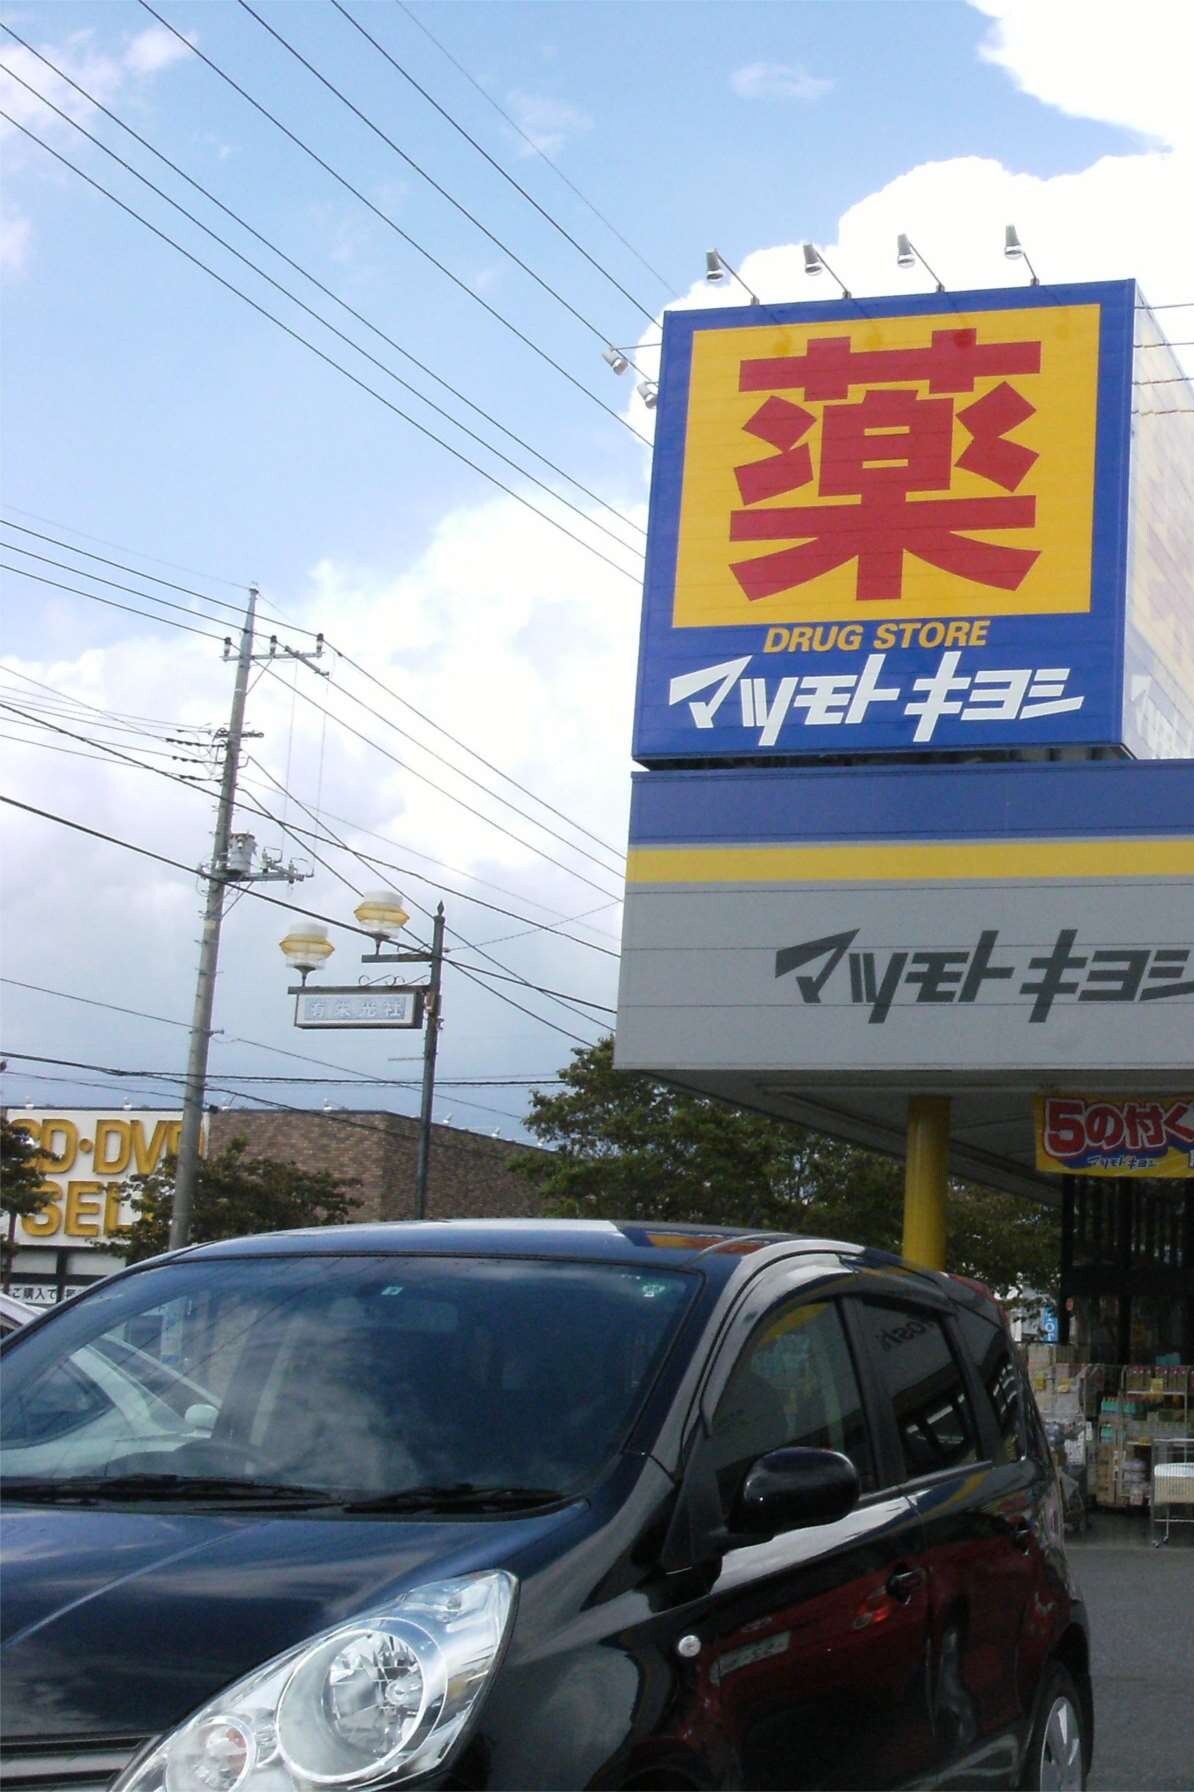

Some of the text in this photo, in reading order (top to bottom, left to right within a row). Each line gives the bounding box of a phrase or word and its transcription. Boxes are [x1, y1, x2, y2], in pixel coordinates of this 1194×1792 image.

[728, 327, 1042, 602] 薬
[763, 620, 991, 654] DRUG STORE
[669, 651, 1085, 747] マツモトキヨシ
